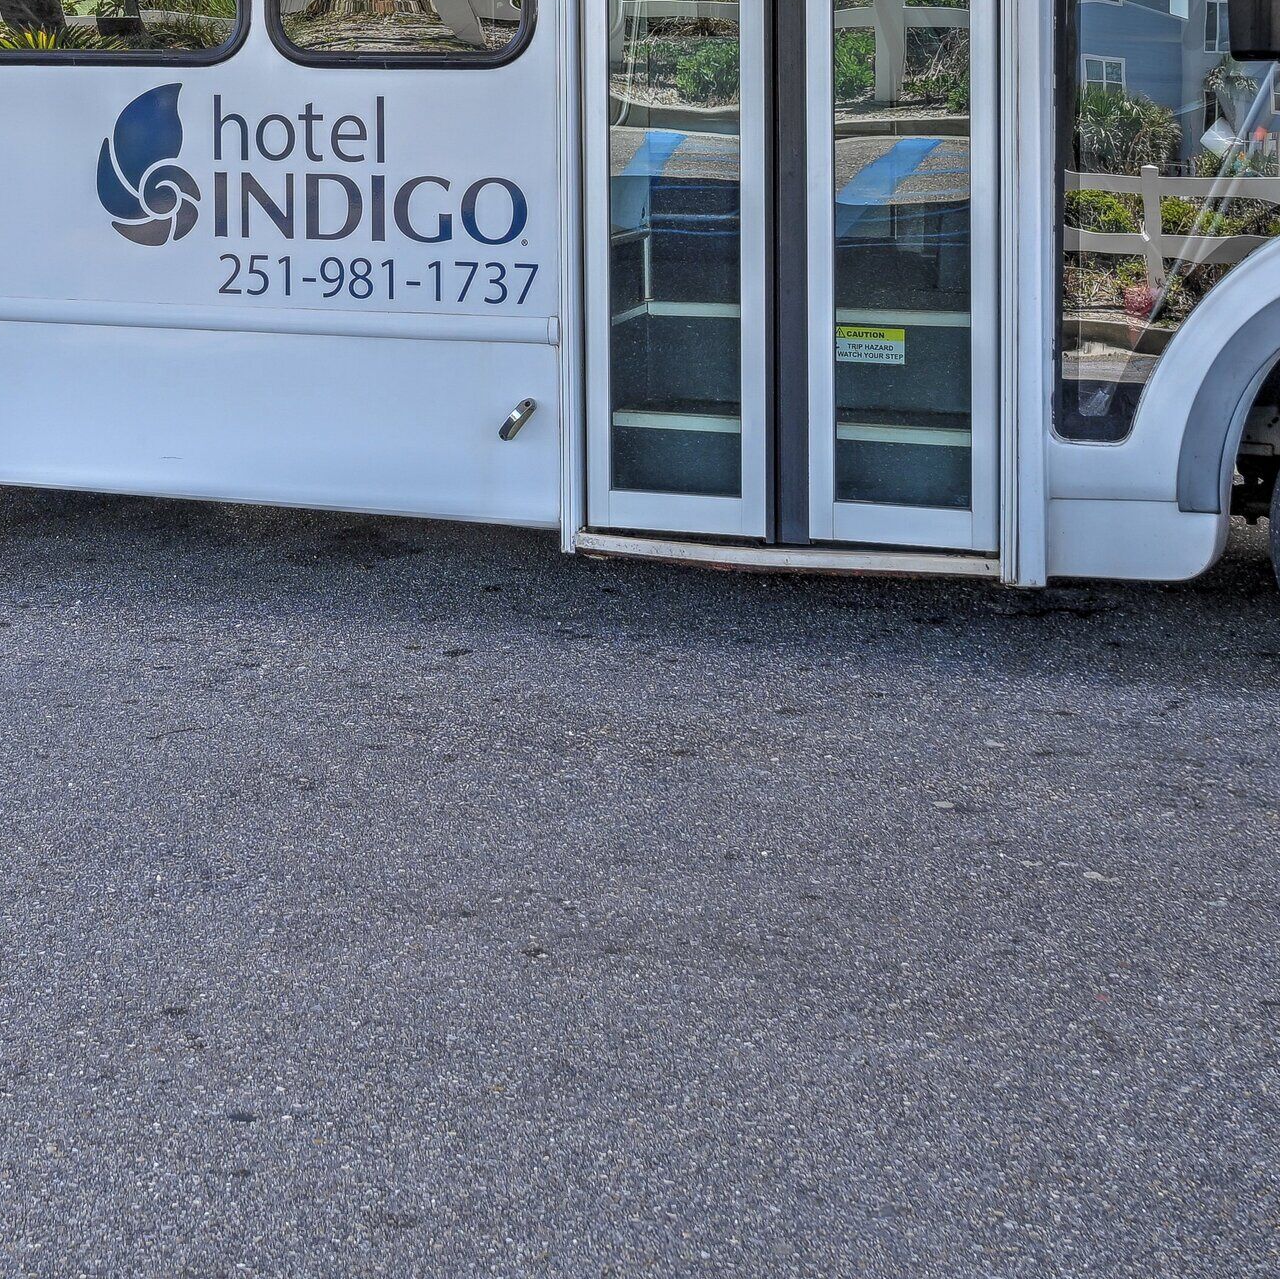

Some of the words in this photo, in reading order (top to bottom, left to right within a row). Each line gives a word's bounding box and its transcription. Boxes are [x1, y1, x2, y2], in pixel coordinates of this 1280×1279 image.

[213, 94, 386, 164] hotel
[214, 171, 529, 246] INDIGO
[217, 253, 540, 306] 251-981-1737
[846, 330, 885, 339] CAUTION
